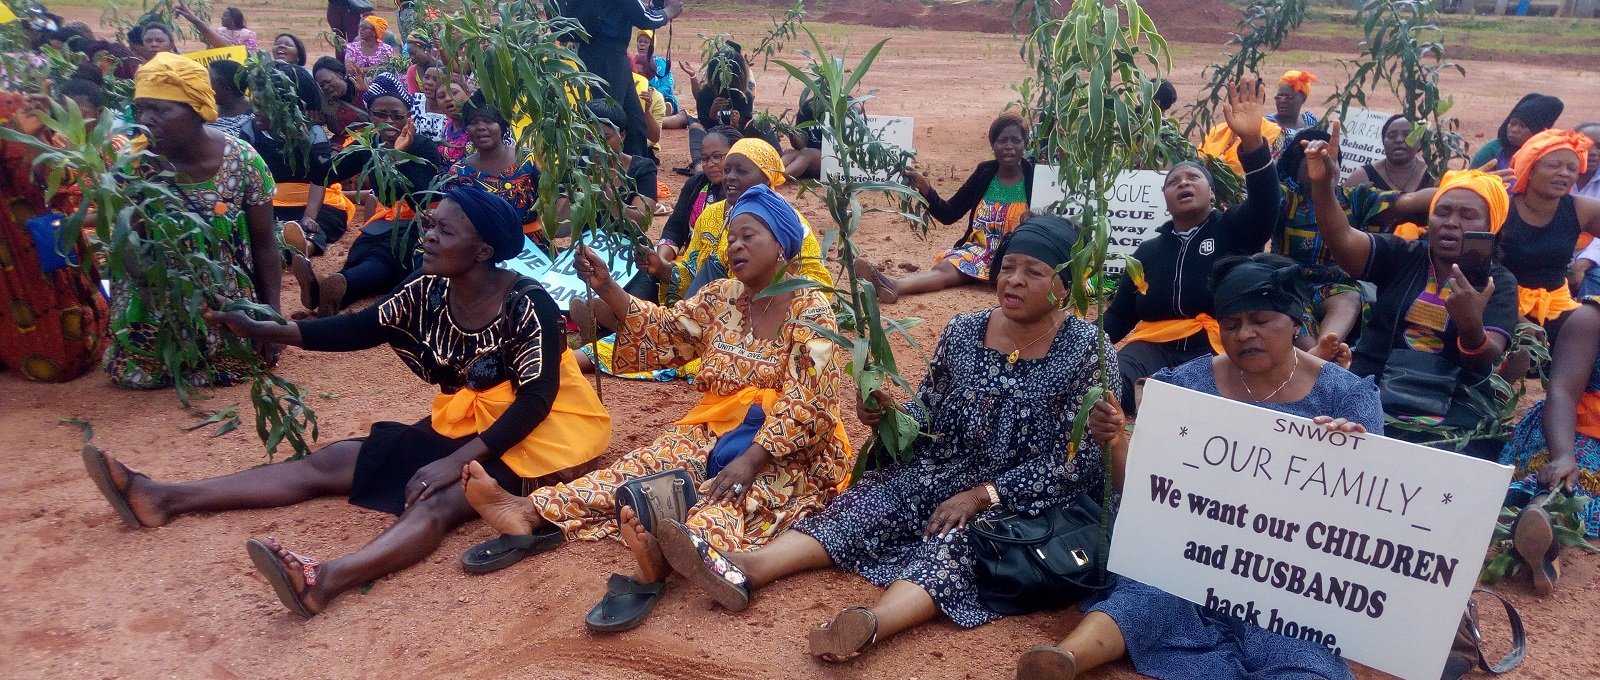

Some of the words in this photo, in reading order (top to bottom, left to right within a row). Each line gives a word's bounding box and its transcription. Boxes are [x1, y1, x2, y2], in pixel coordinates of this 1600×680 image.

[1341, 139, 1374, 152] Behold
[717, 342, 735, 352] UNITY
[1273, 418, 1366, 450] SNWOT
[1149, 474, 1182, 508] We
[1187, 492, 1247, 528] want
[1252, 512, 1300, 543] our
[1305, 520, 1459, 588] CHILDREN
[1183, 539, 1229, 571] and
[1230, 548, 1387, 619] HUSBANDS
[1204, 587, 1261, 626] back
